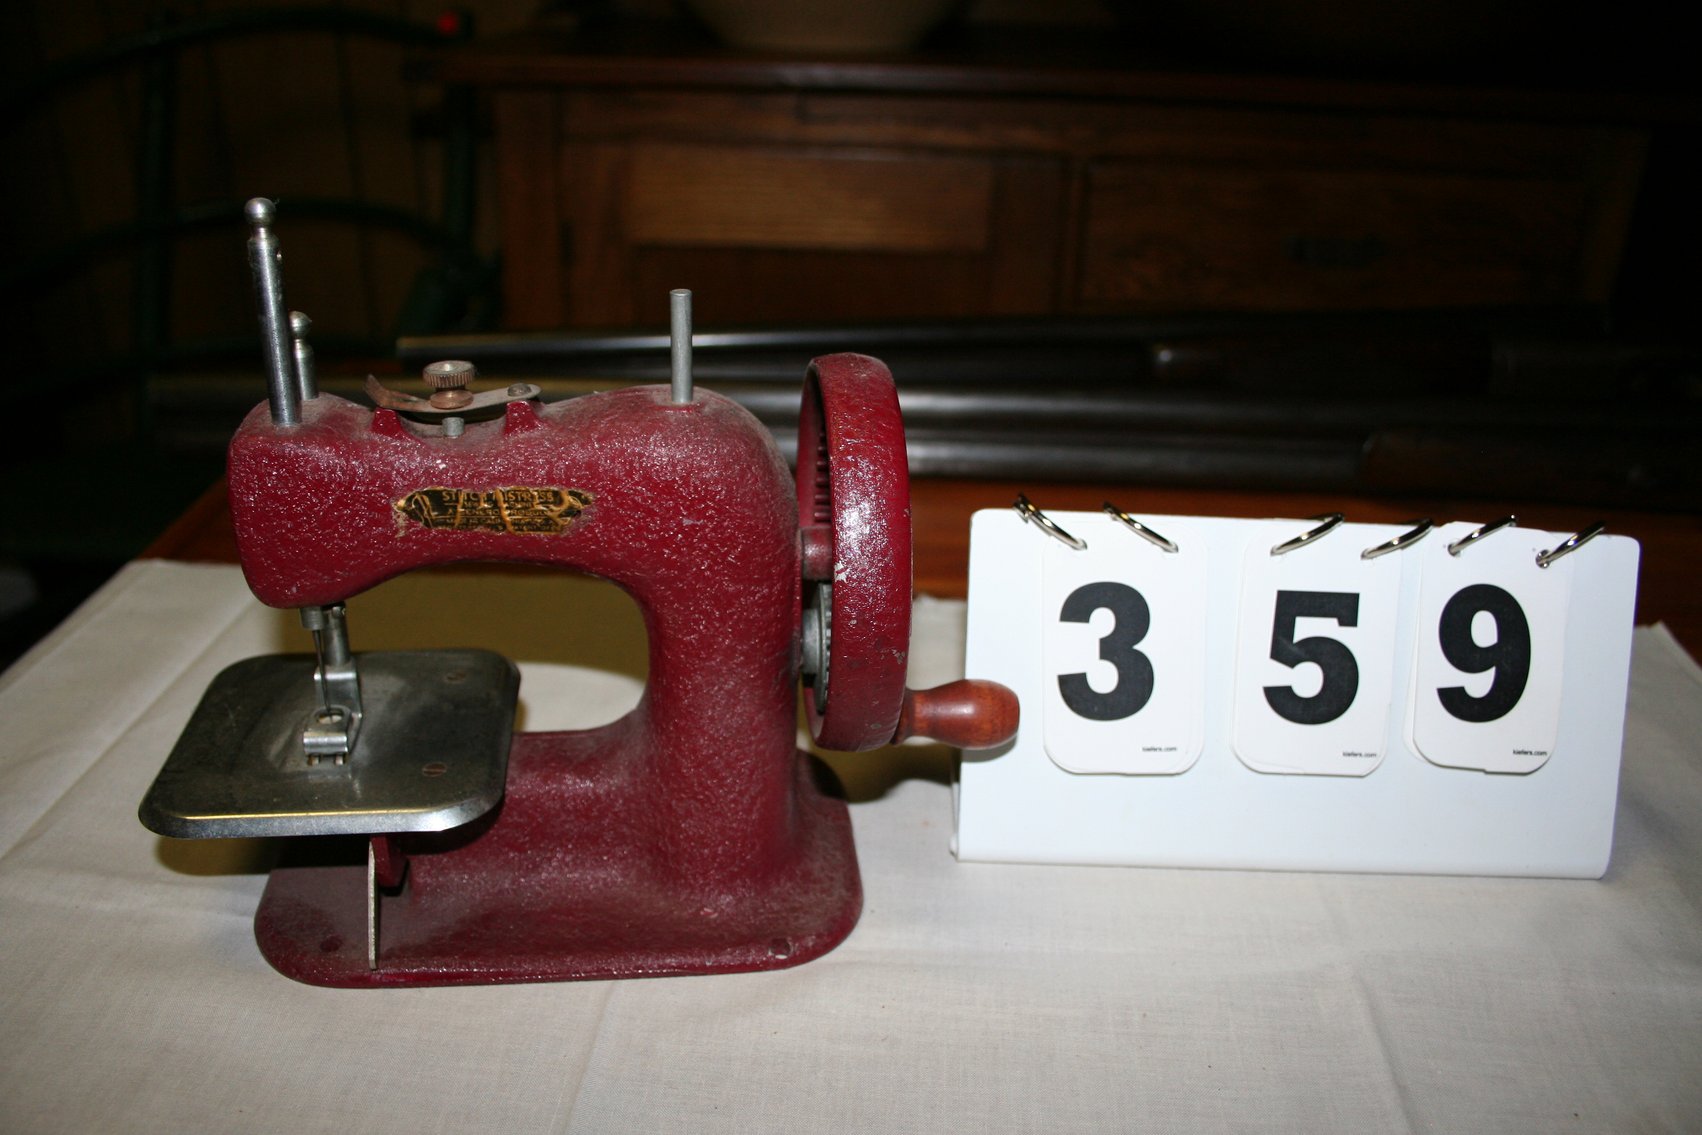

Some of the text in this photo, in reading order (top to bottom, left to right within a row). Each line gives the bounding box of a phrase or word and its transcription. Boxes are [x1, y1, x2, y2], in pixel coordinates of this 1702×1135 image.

[1058, 582, 1531, 725] 3 5 9
